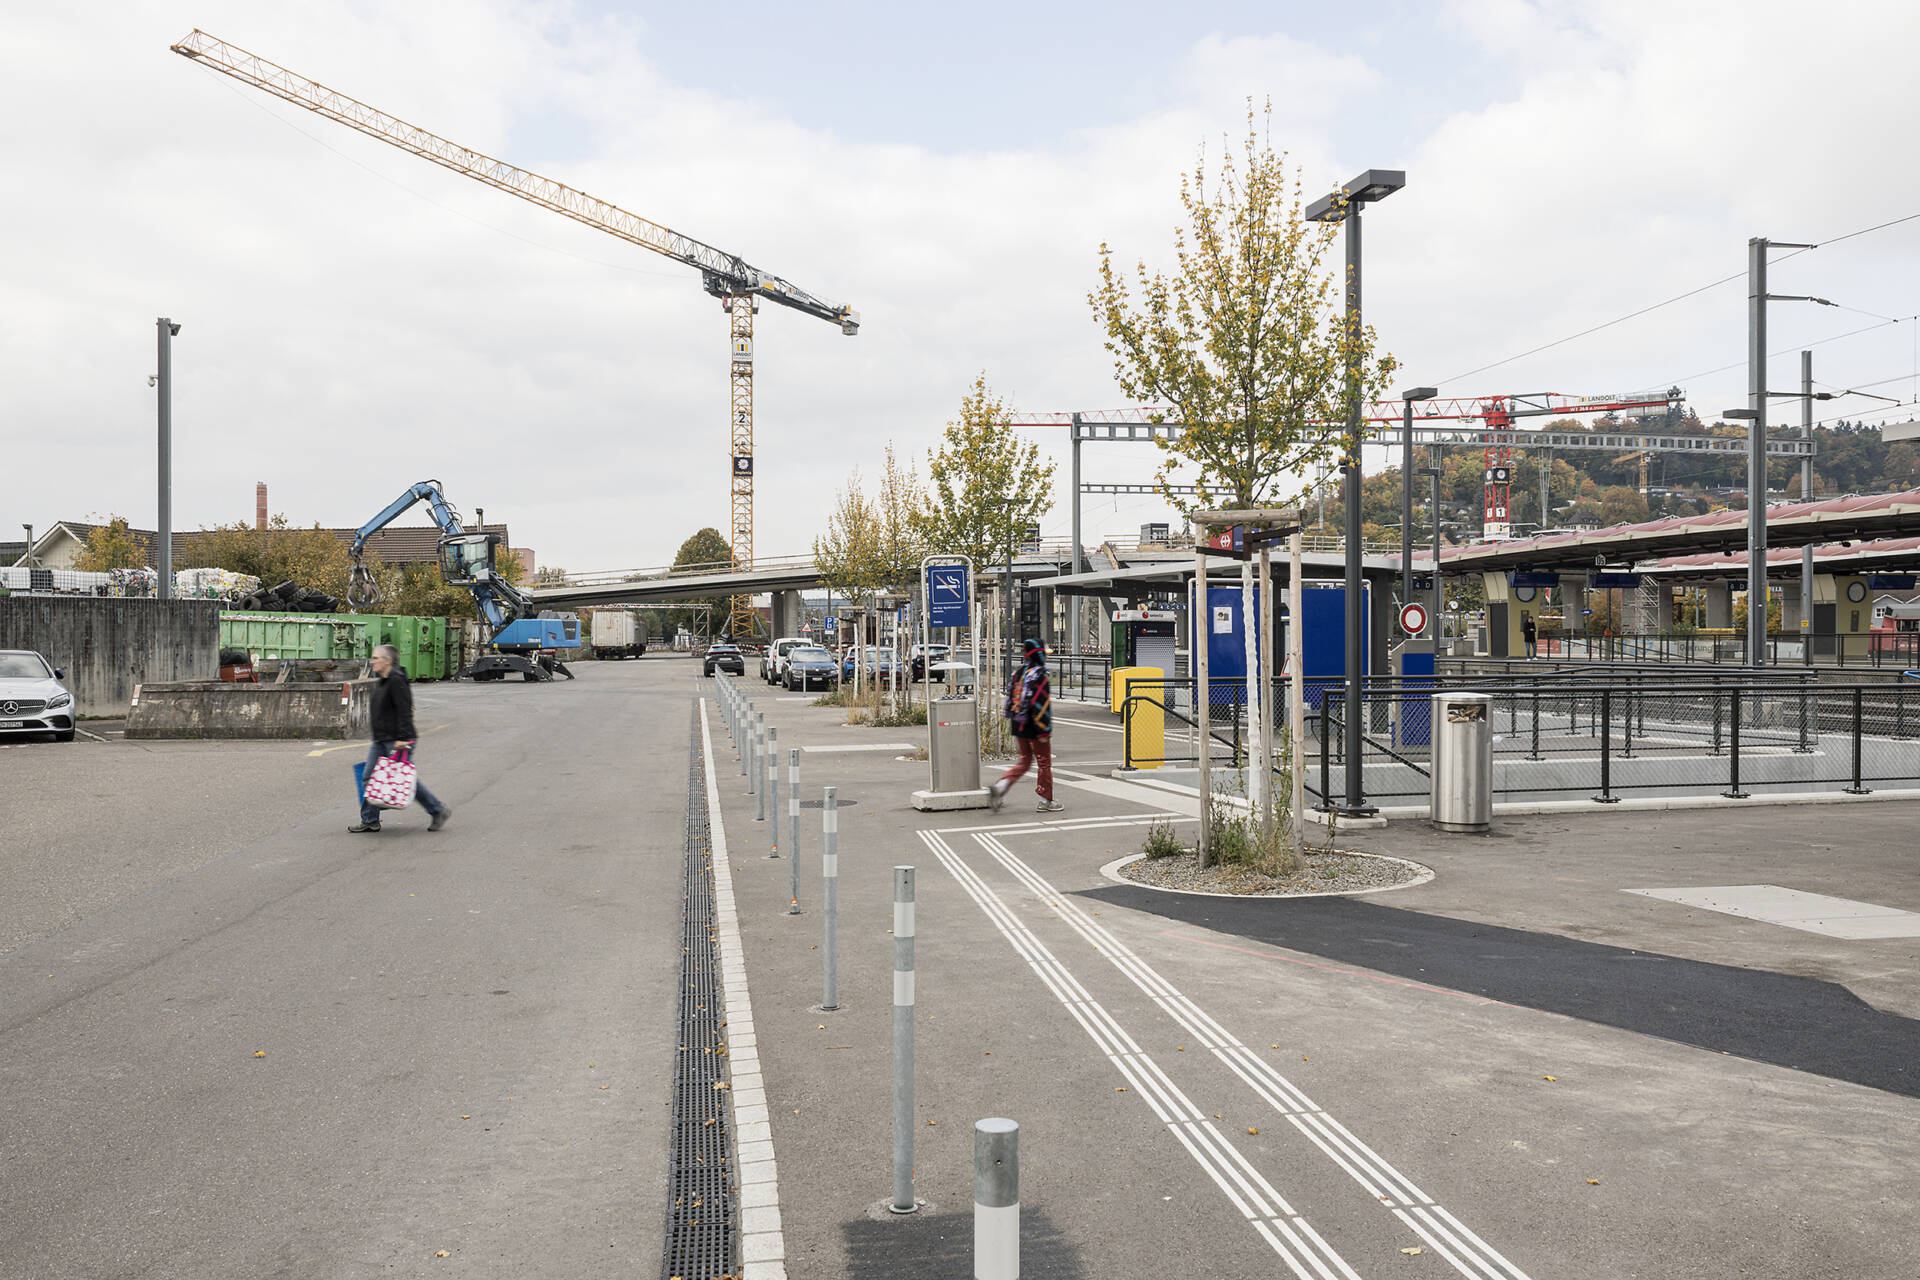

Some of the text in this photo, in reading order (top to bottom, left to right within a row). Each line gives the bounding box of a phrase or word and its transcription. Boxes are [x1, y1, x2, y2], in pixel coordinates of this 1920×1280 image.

[1588, 394, 1615, 402] LANDOLT
[738, 414, 746, 423] 2
[1497, 508, 1503, 516] 1
